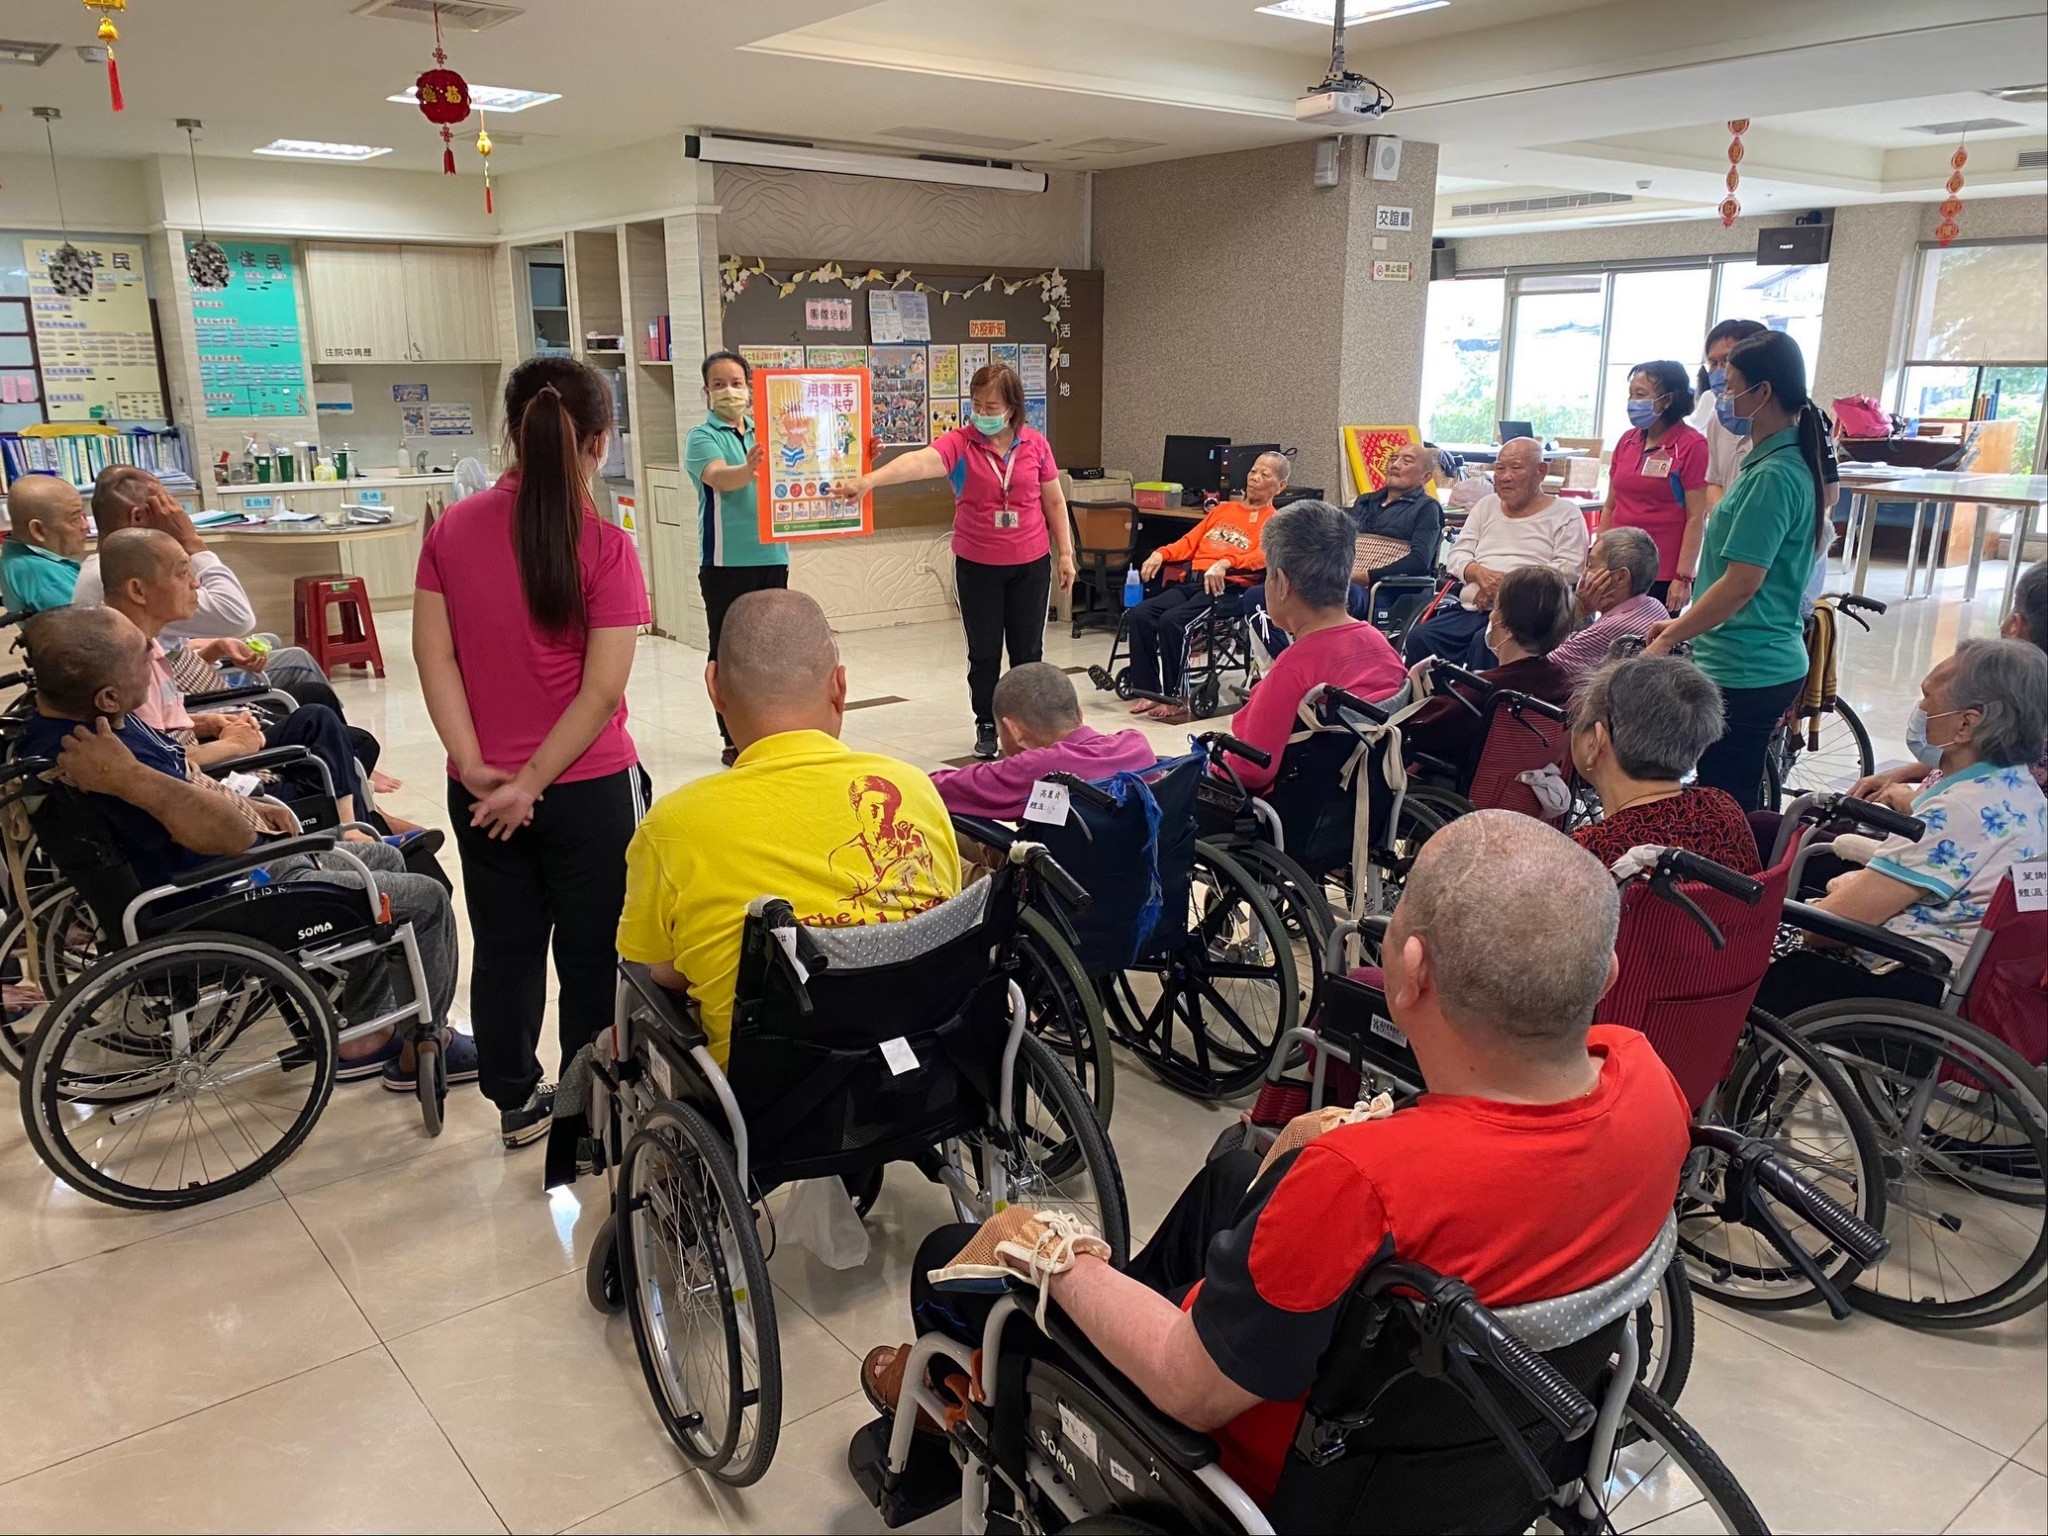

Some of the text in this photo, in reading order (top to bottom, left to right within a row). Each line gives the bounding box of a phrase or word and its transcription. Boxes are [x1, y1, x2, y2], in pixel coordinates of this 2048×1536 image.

[1379, 210, 1410, 226] 交誼廳
[298, 922, 333, 940] SOMA
[1040, 1429, 1076, 1482] SOMA
